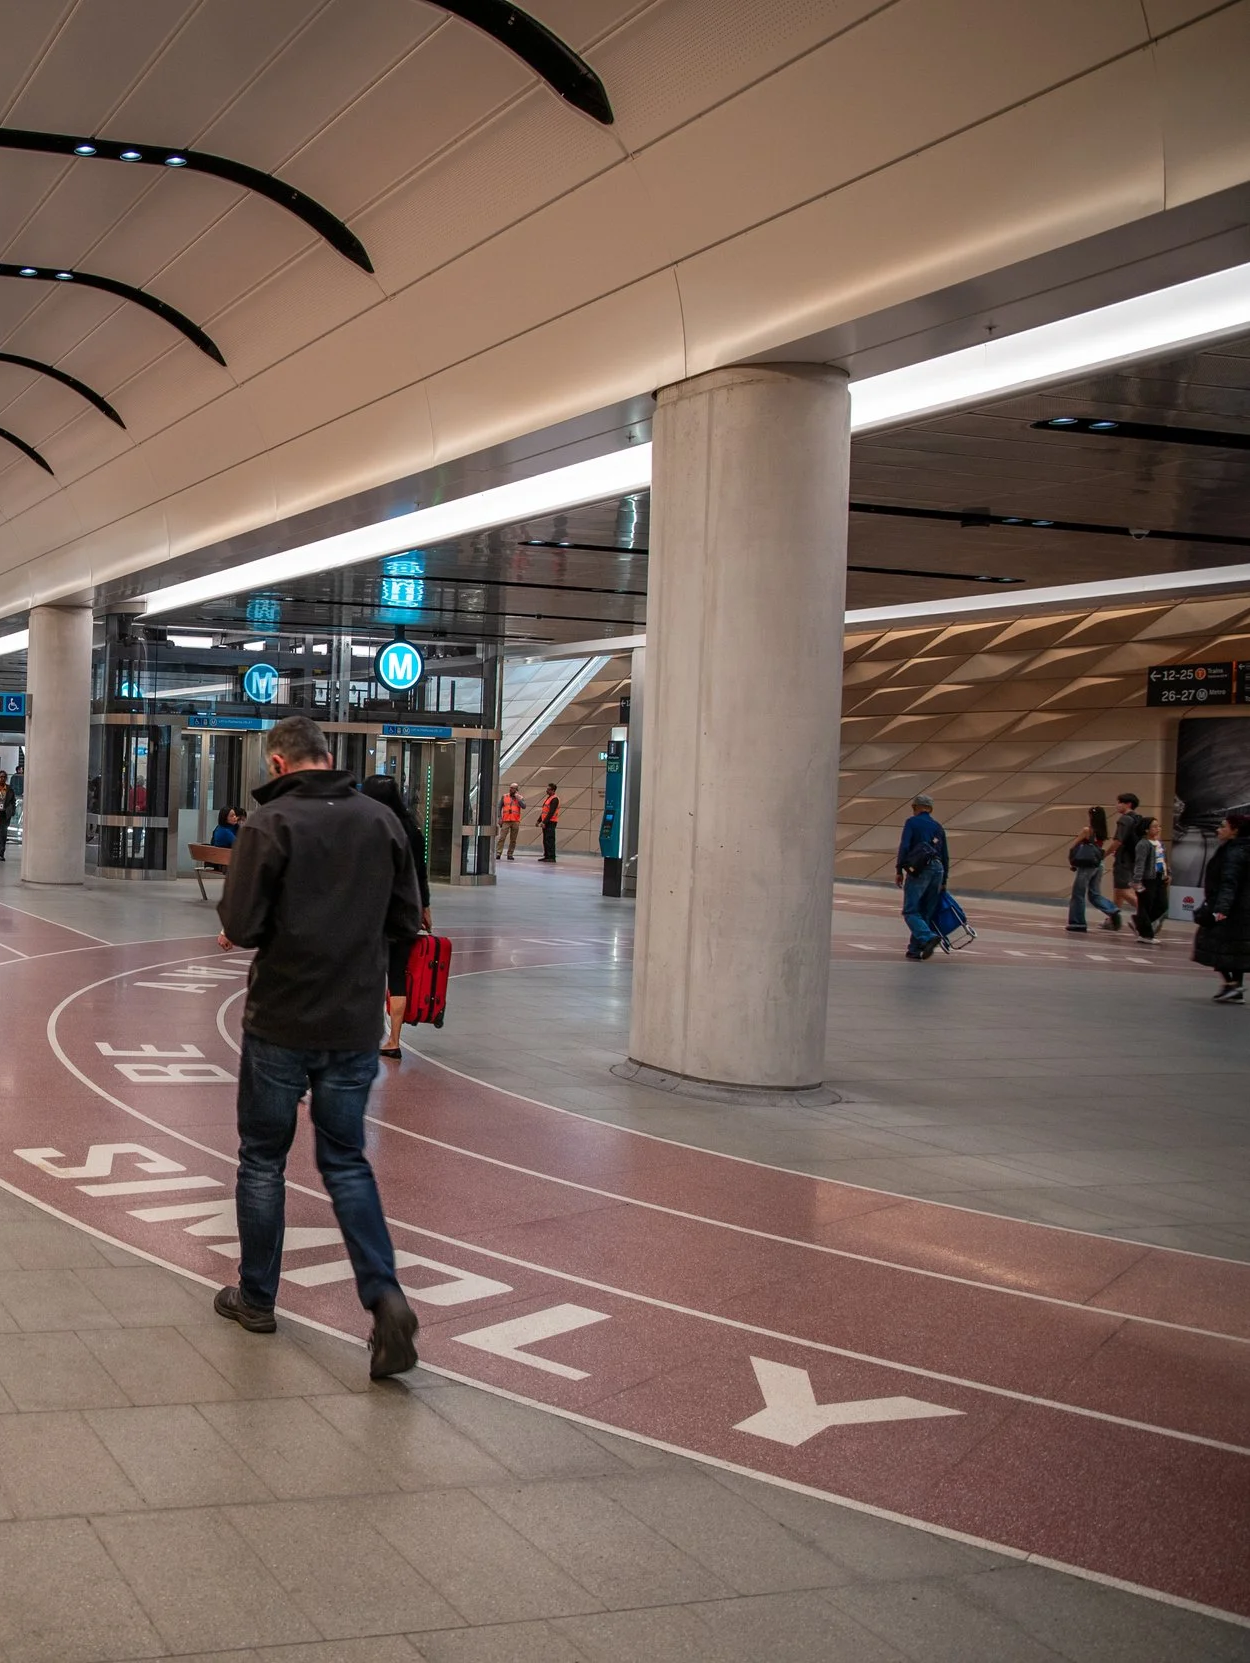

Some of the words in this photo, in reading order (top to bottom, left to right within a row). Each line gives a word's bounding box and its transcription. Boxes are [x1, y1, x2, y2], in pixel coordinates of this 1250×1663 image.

[1162, 669, 1194, 681] 12-25
[1161, 690, 1196, 702] 26-27
[95, 1041, 239, 1083] BE
